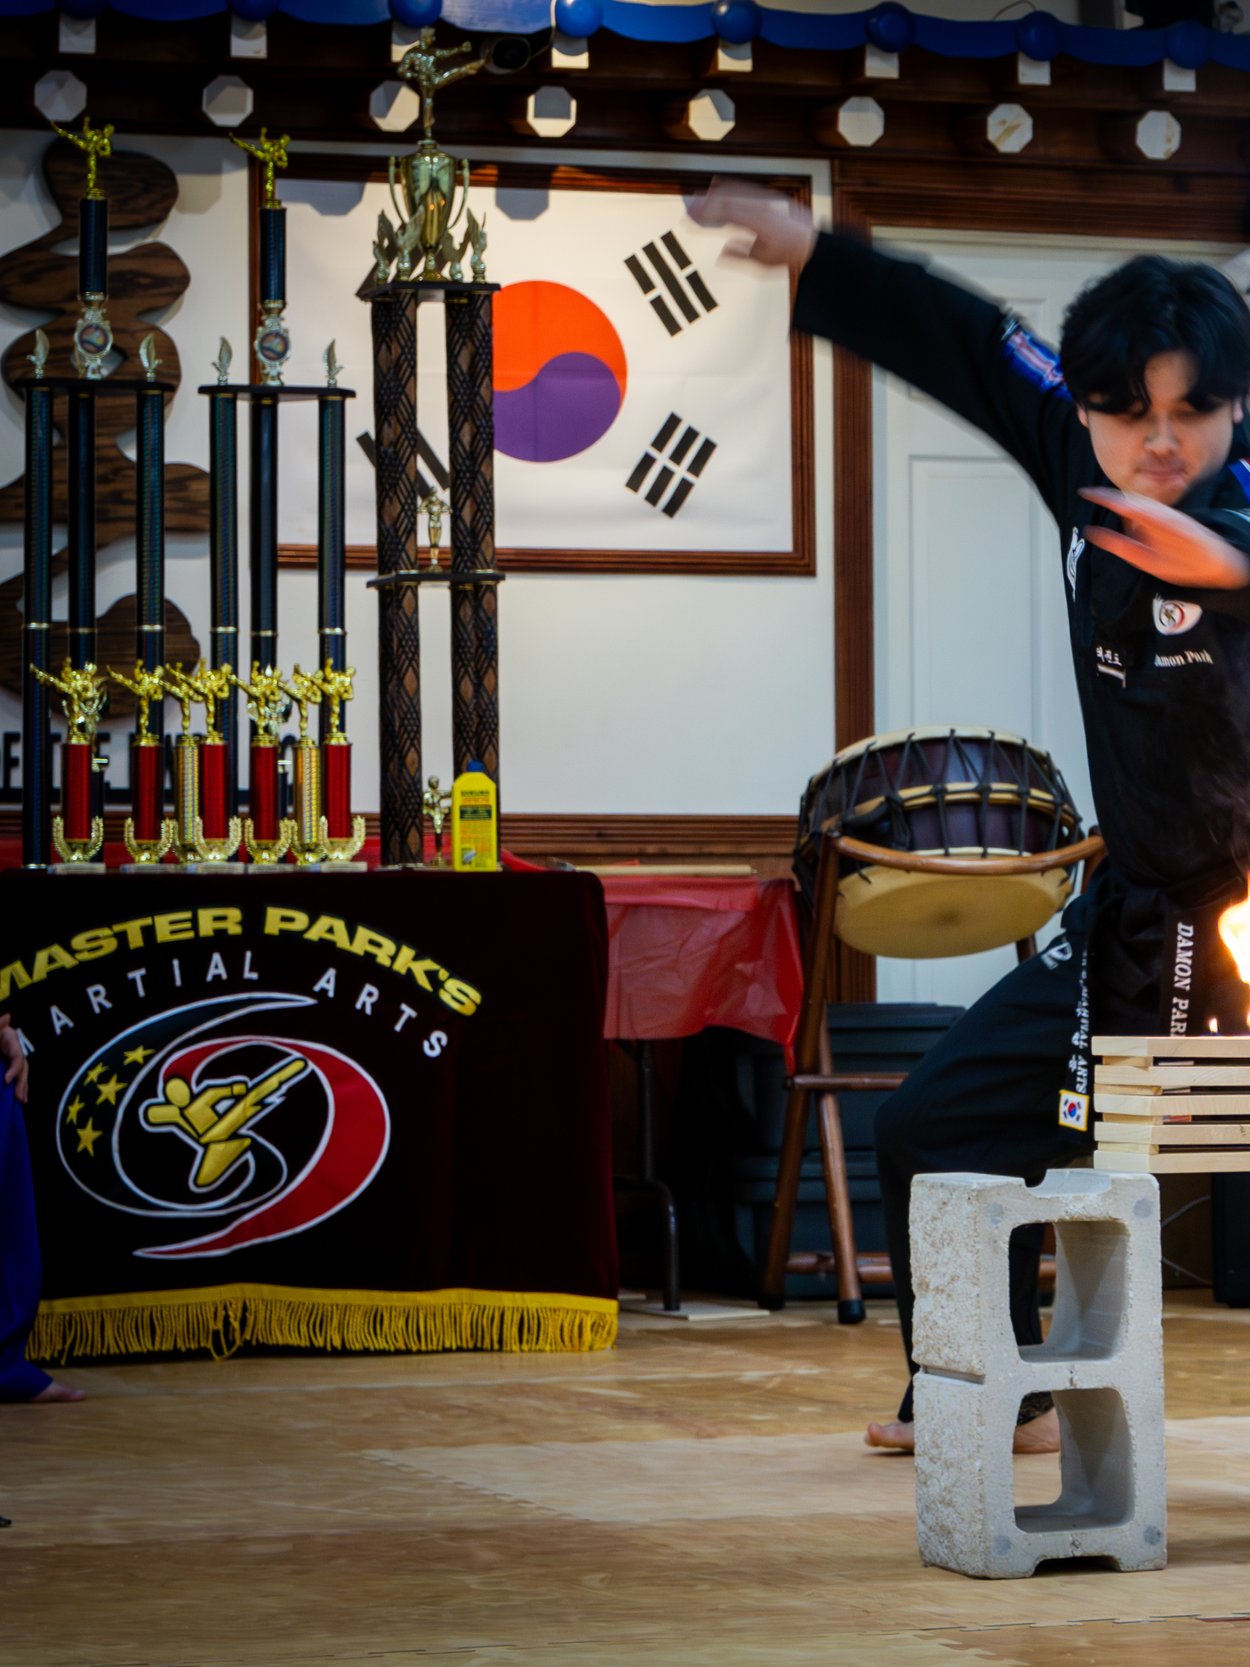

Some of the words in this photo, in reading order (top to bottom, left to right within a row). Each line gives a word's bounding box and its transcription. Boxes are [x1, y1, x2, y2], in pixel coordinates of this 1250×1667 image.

[263, 907, 482, 1016] PARK'S
[1175, 922, 1194, 991] DAMON
[314, 968, 448, 1058] ARTS
[1171, 997, 1189, 1037] PAR
[1076, 1054, 1088, 1094] ARTS
